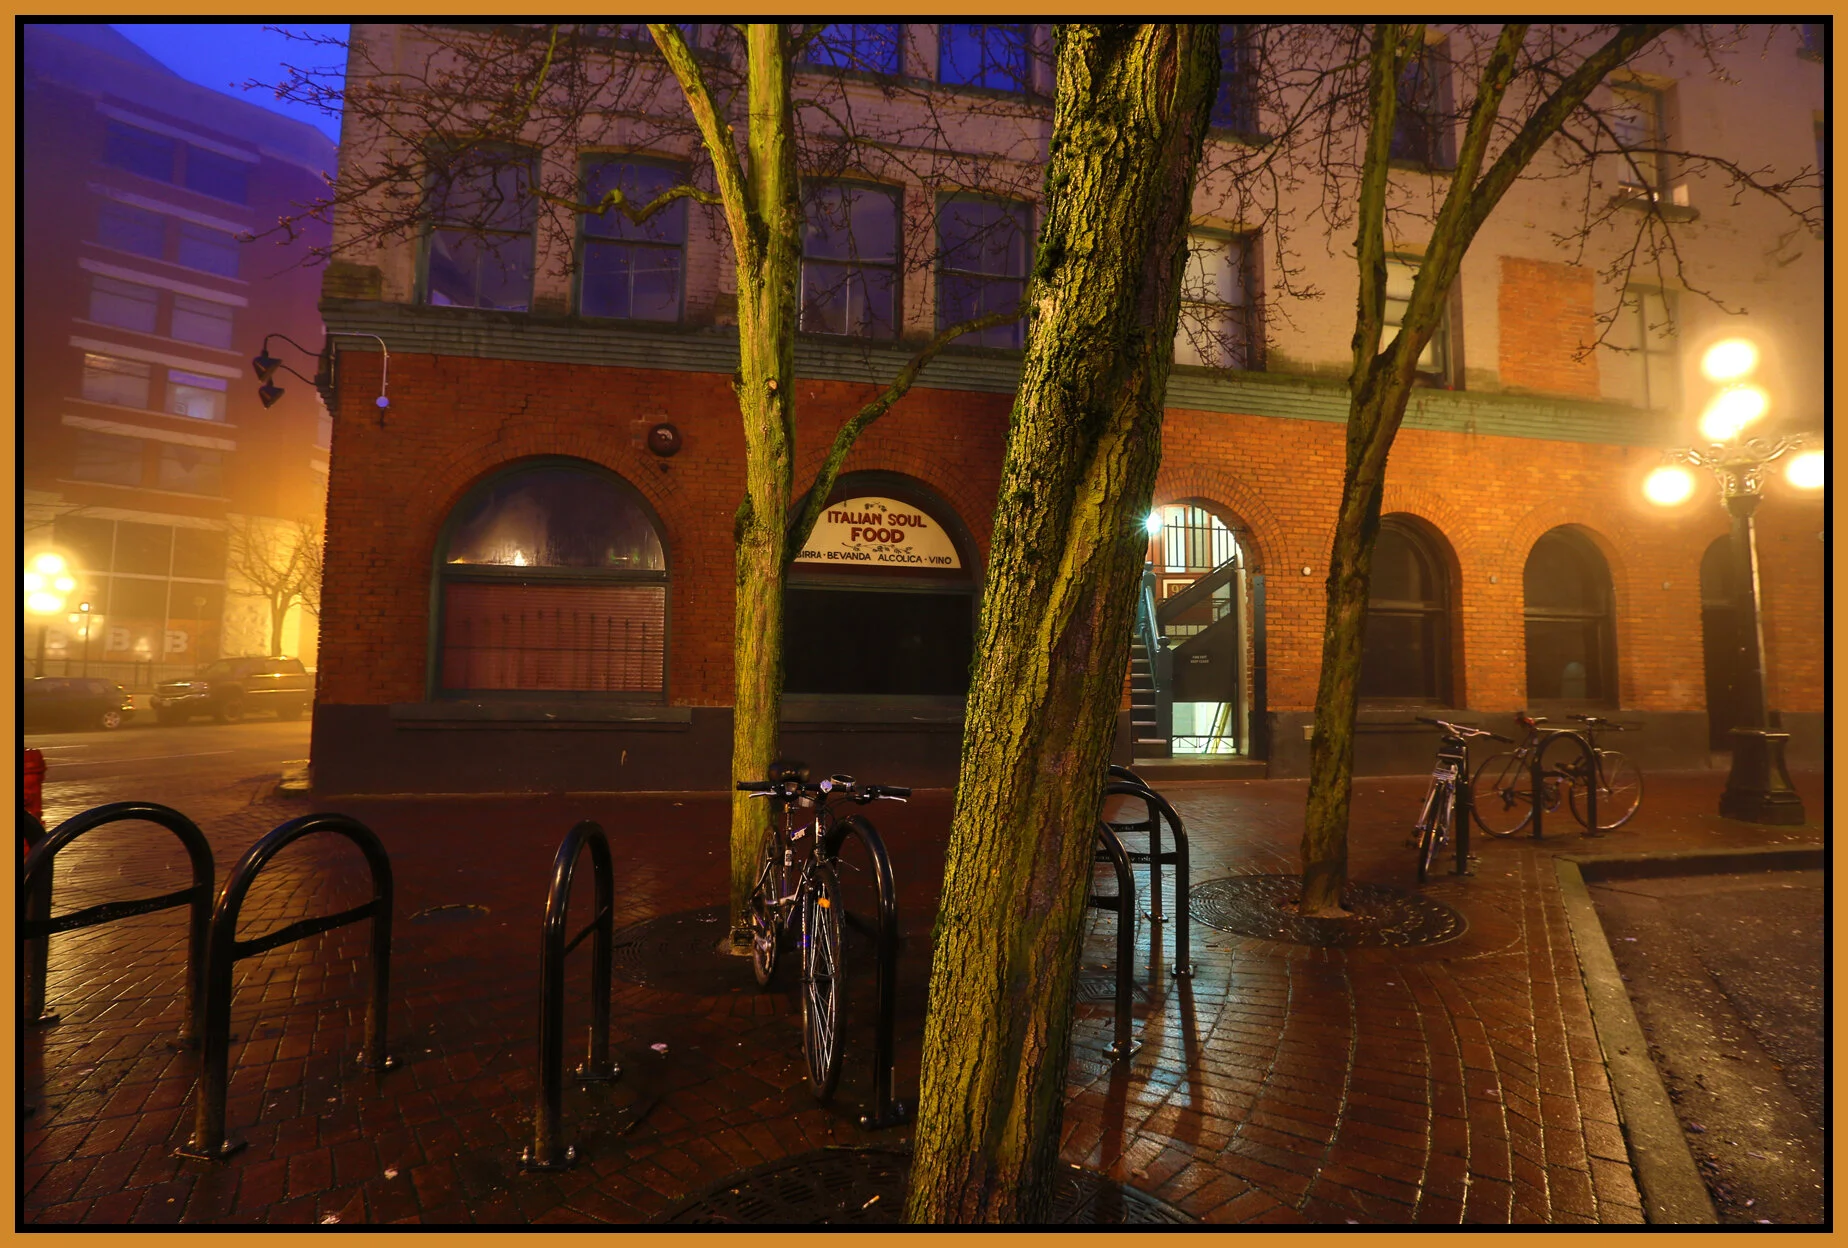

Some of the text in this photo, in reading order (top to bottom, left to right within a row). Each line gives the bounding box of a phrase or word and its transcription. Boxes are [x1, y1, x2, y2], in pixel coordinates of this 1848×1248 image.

[827, 510, 927, 528] ITALIAN SOUL
[851, 526, 905, 543] FOOD
[827, 551, 871, 561] BEVANDA
[877, 553, 923, 563] ALCOLICA
[929, 556, 952, 565] VINO
